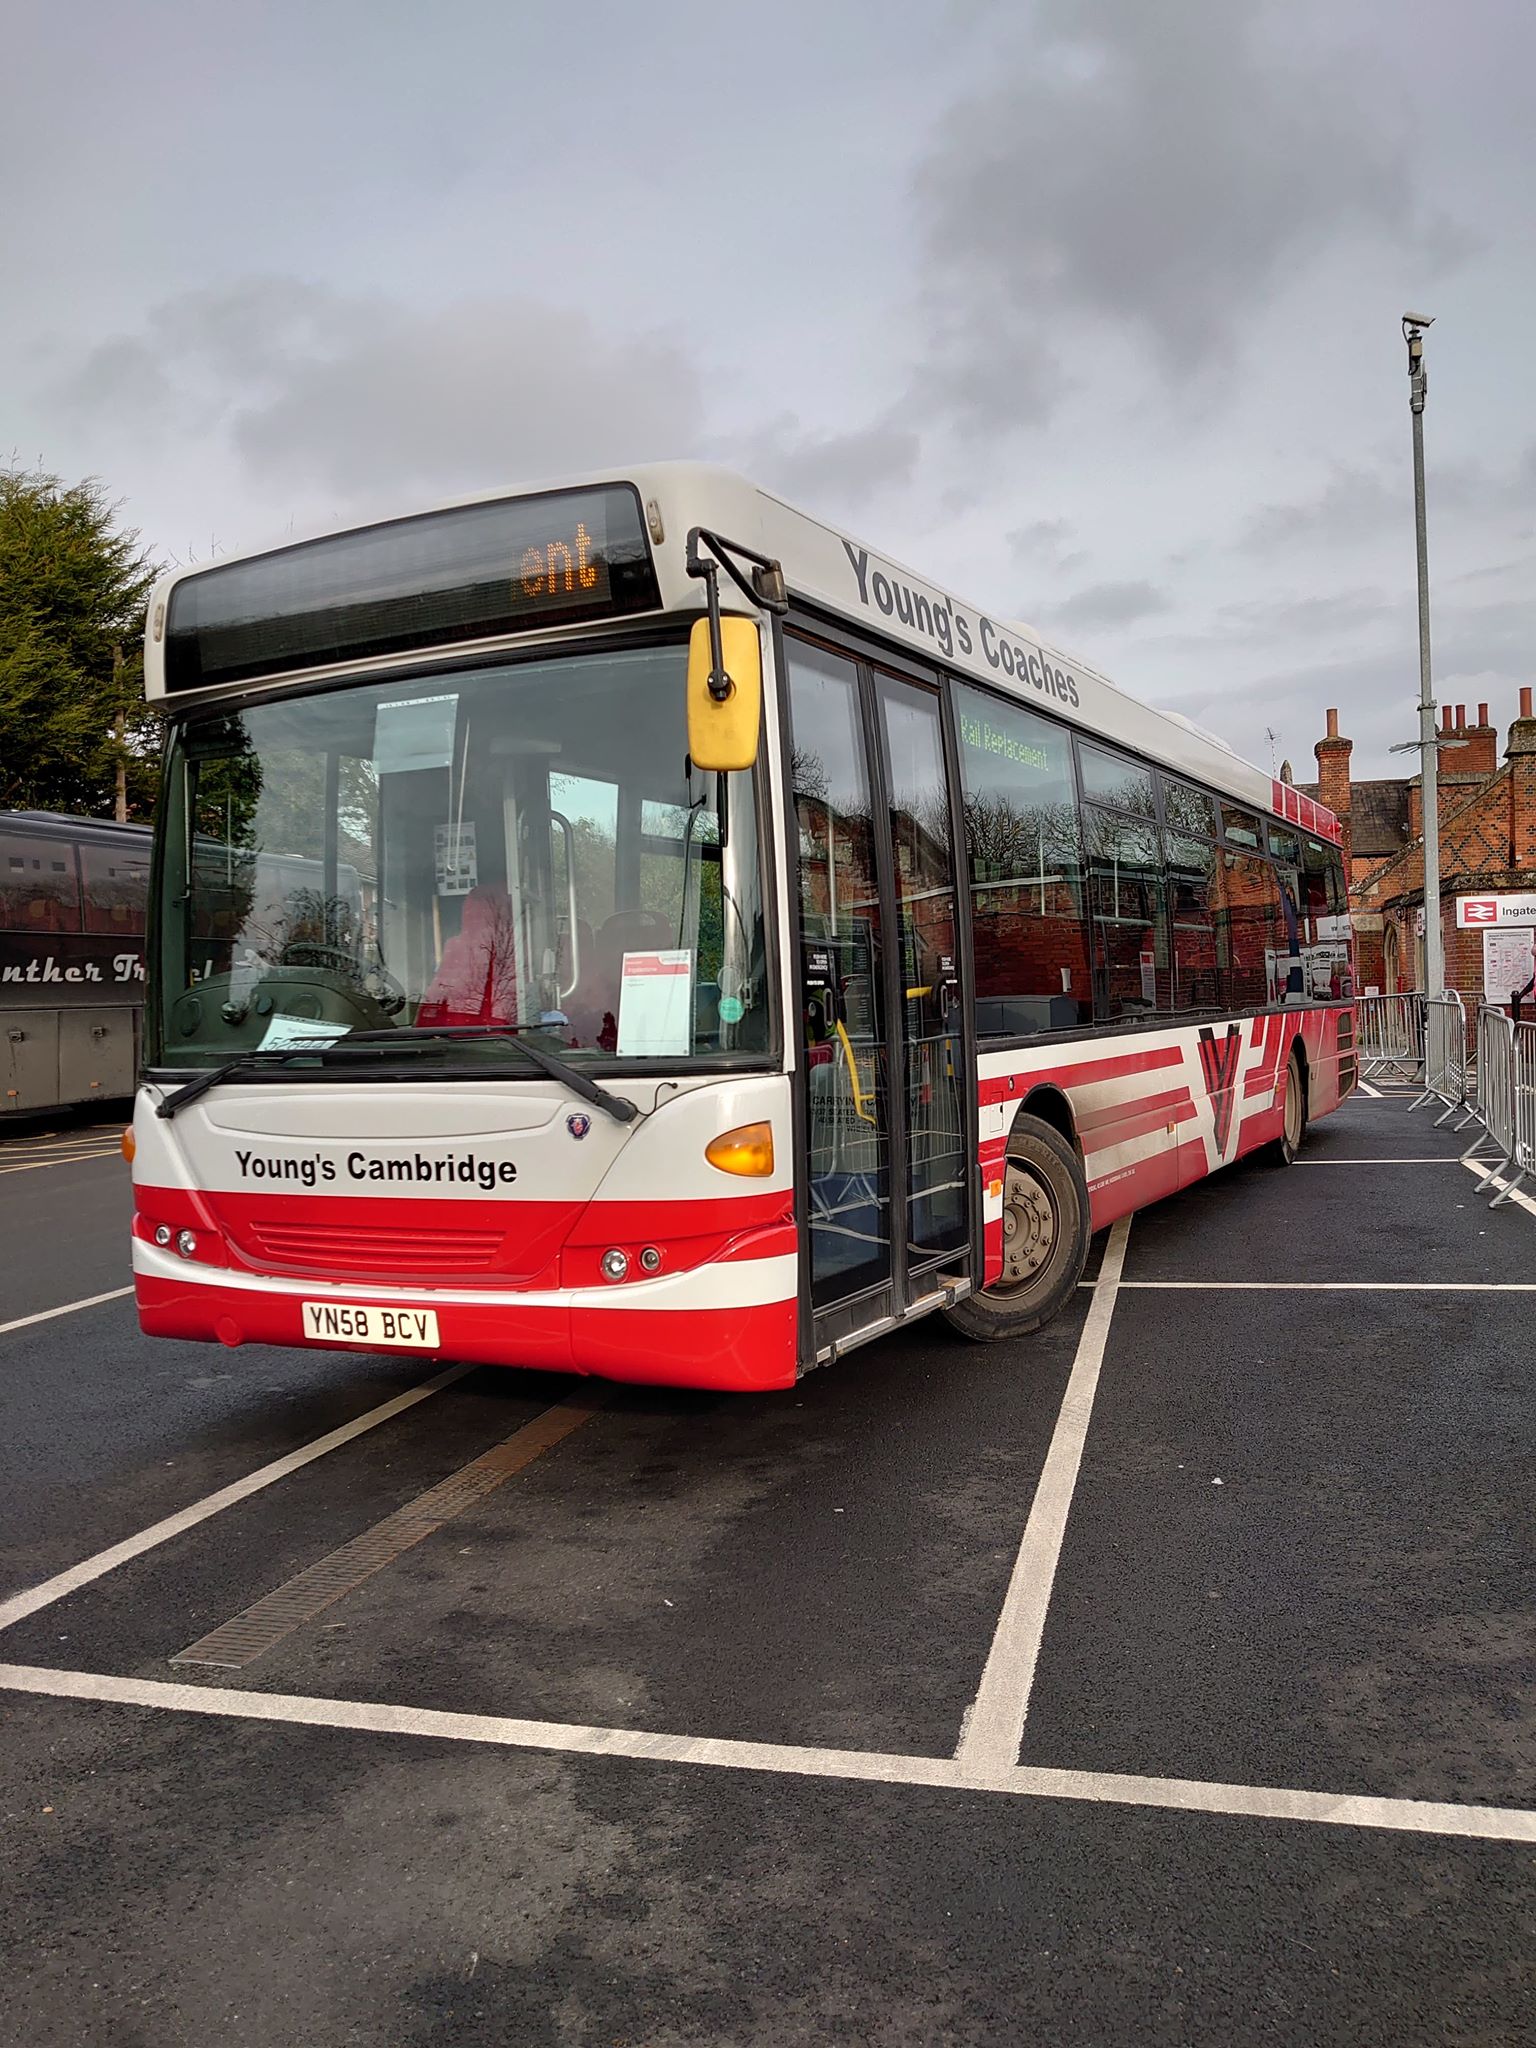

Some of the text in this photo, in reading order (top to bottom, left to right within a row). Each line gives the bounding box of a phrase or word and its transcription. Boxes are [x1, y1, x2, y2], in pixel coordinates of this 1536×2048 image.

[841, 539, 1080, 709] Young's Coaches
[960, 714, 1049, 772] Rail Replacement
[812, 1096, 856, 1105] CARRYIN
[235, 1151, 517, 1190] Young's Cambridge
[309, 1306, 427, 1341] YN58 BCV
